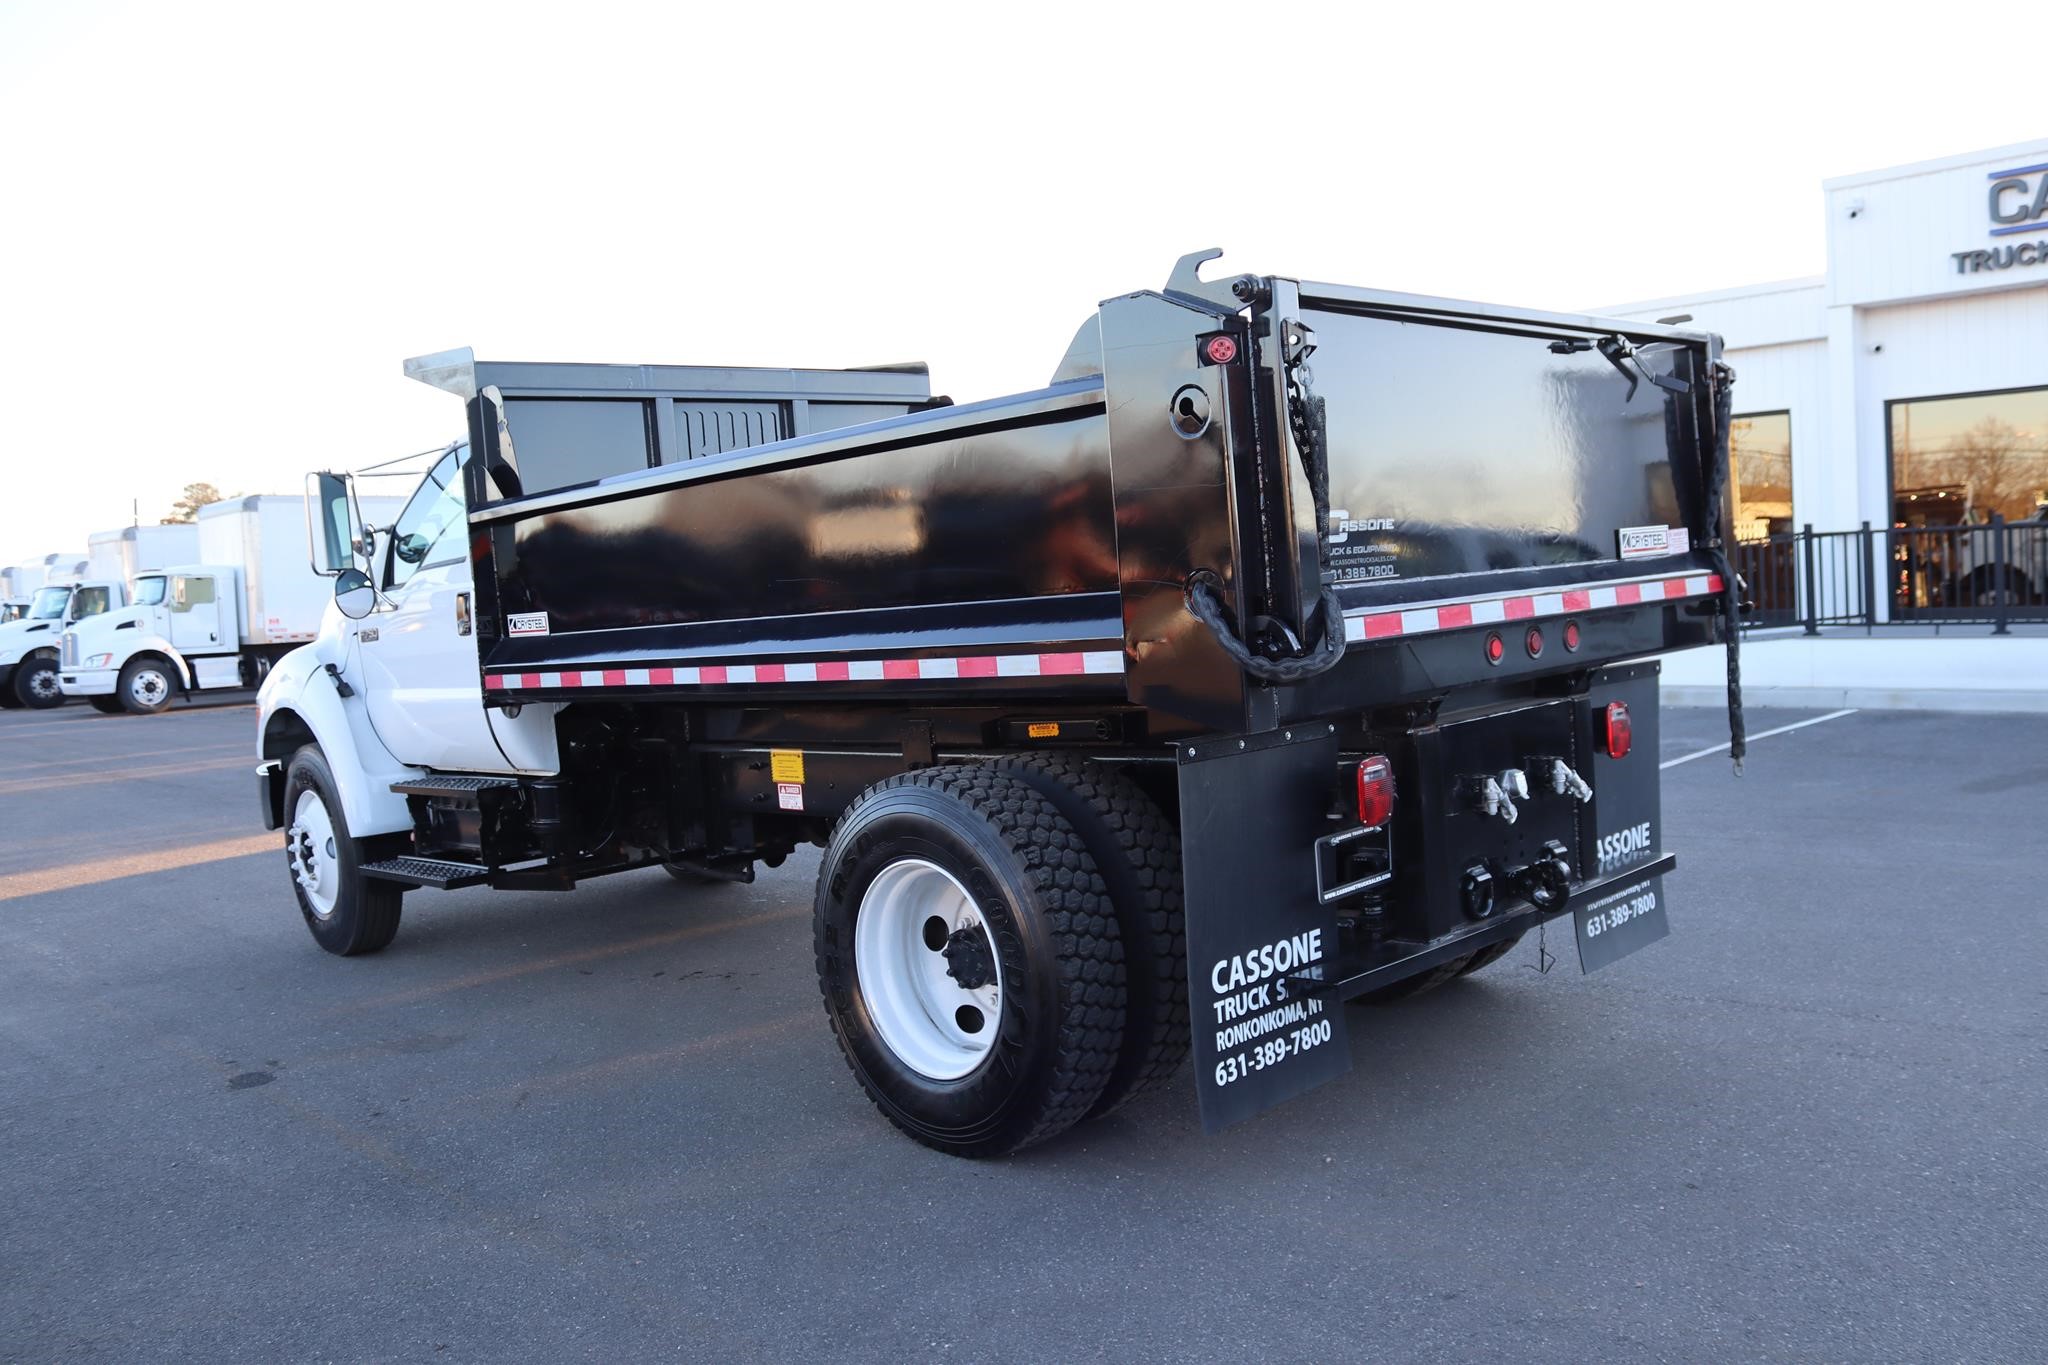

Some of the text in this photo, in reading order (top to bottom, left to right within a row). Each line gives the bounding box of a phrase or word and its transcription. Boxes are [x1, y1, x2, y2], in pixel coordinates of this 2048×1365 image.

[1329, 546, 1345, 556] UCK
[1631, 533, 1666, 548] CRYSTEEL
[1330, 564, 1394, 580] 31.389.7800
[517, 618, 546, 630] CRYSTEEL
[1597, 822, 1650, 862] ASSONE
[1587, 892, 1656, 938] 631-389-7800
[1211, 928, 1322, 994] CASSONE
[1213, 983, 1271, 1024] TRUCK
[1216, 1001, 1307, 1052] RONKONKOMA,
[1215, 1019, 1331, 1087] 631-389-7800
